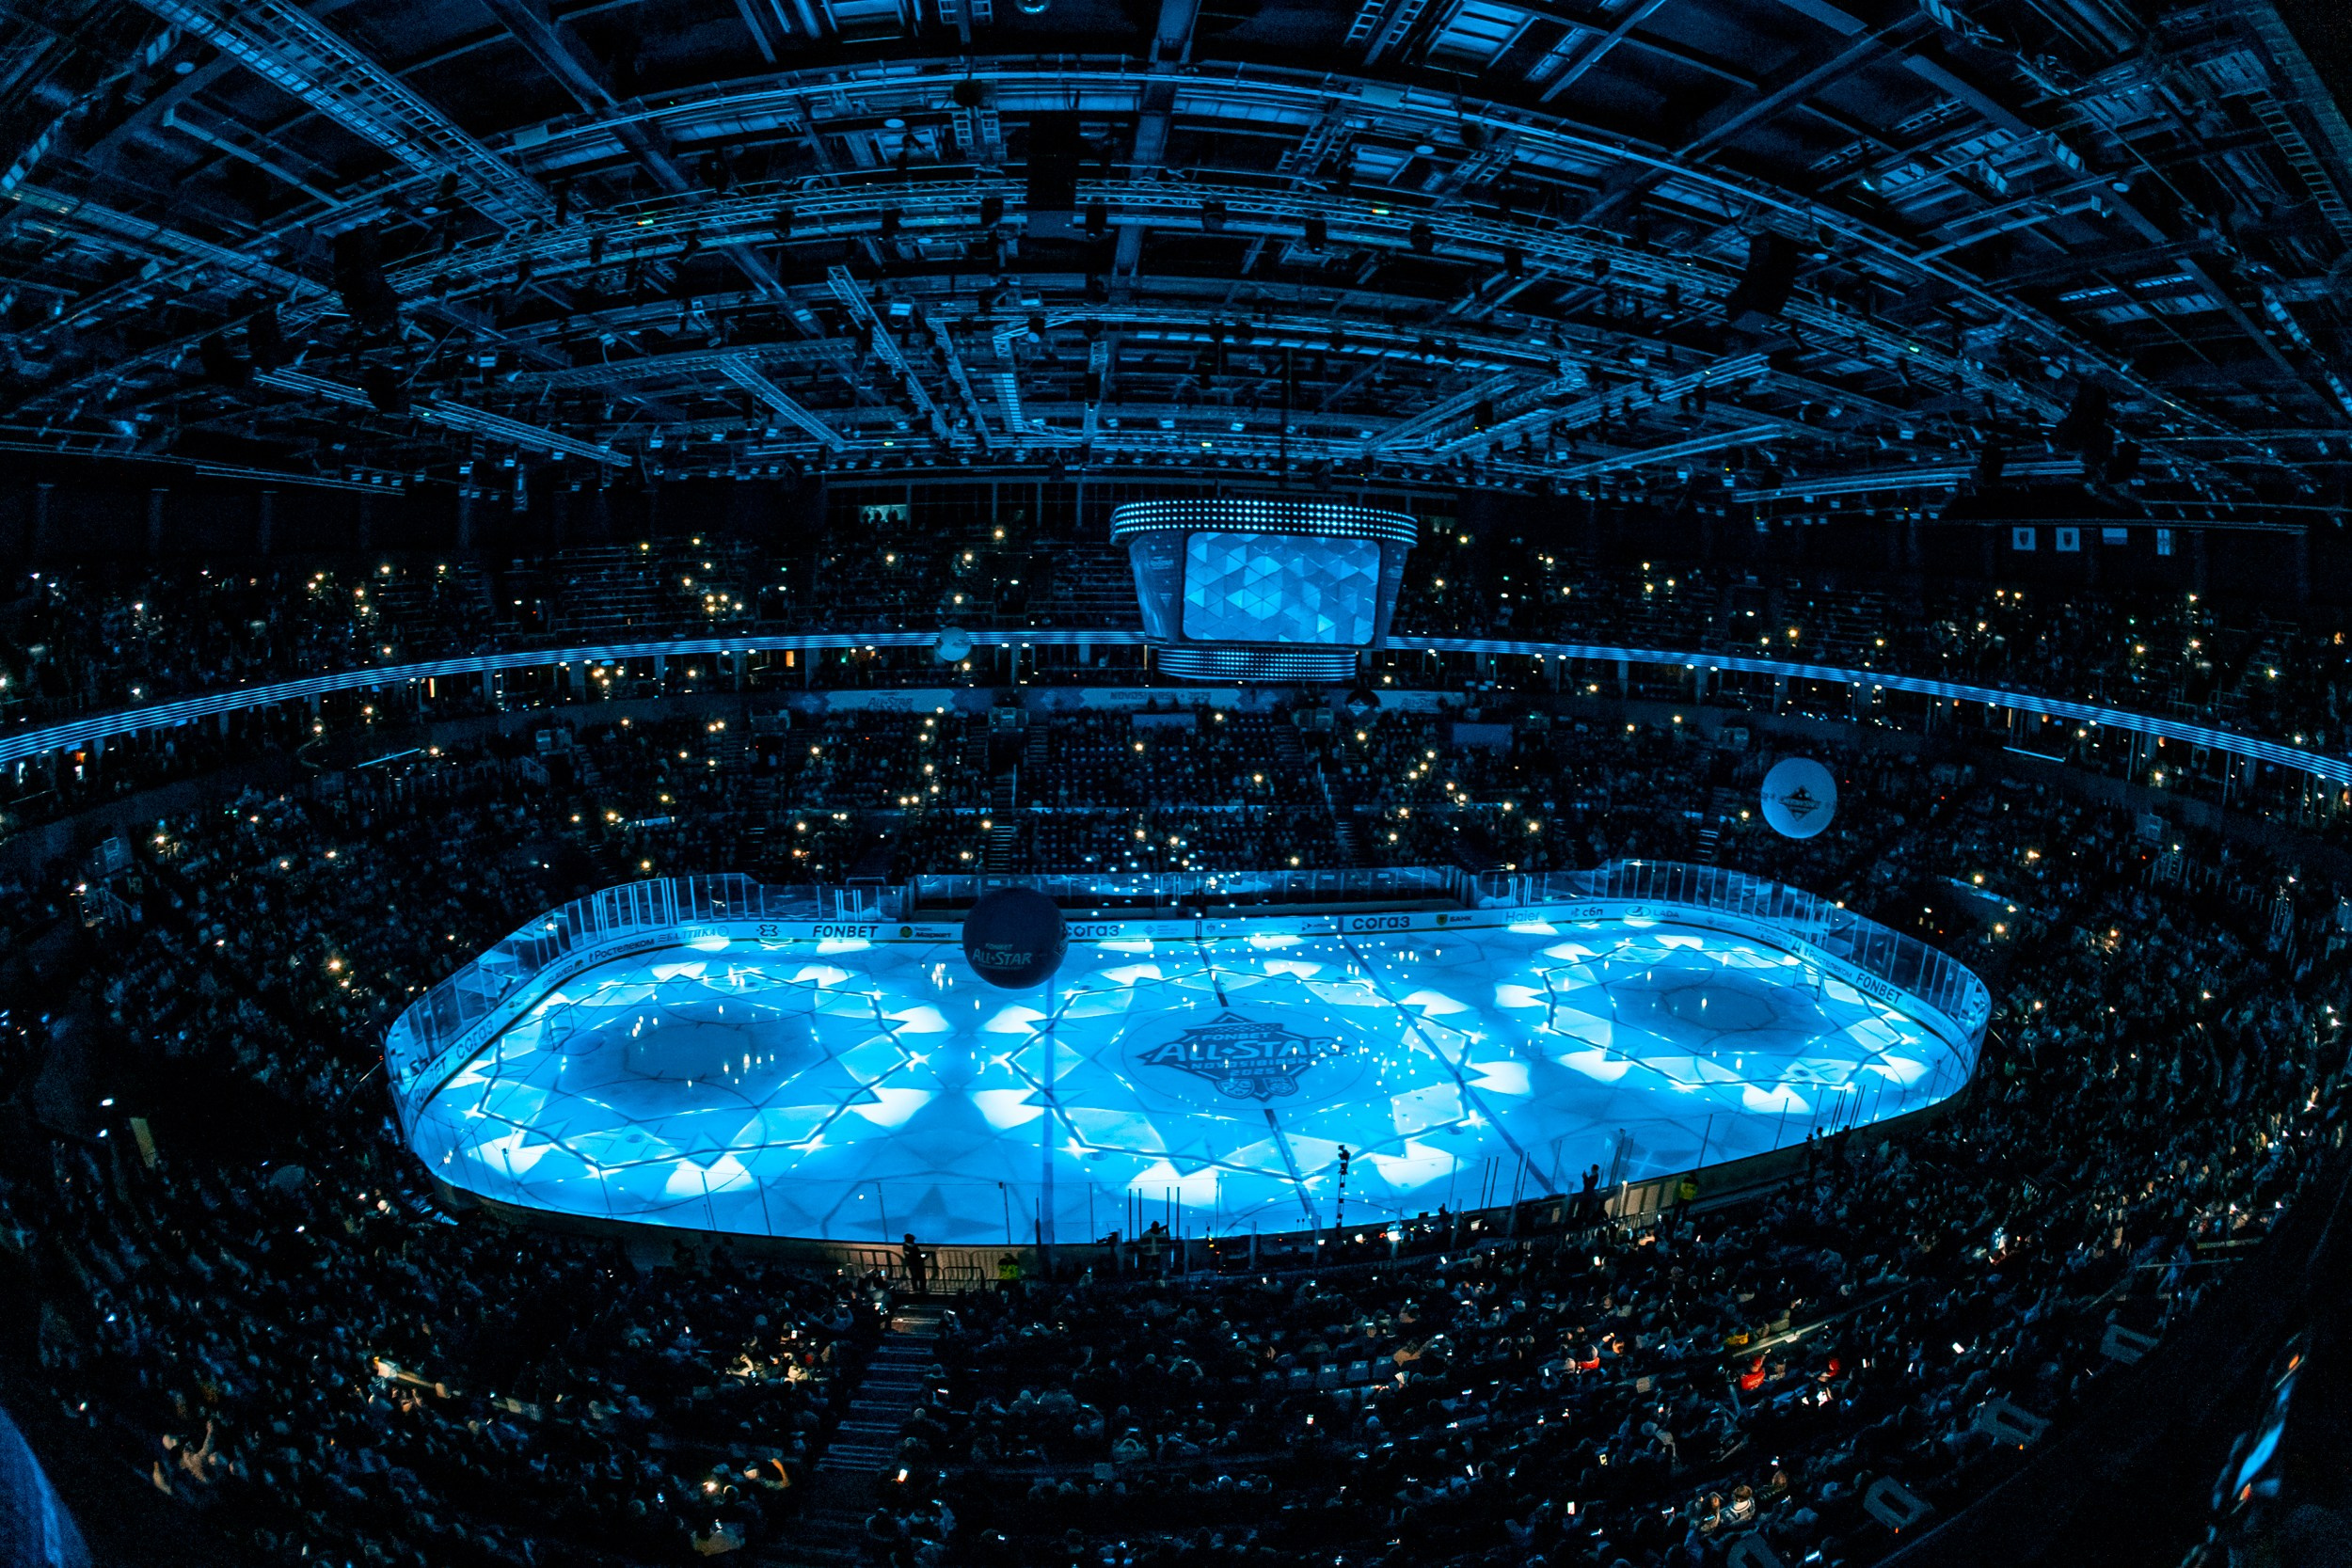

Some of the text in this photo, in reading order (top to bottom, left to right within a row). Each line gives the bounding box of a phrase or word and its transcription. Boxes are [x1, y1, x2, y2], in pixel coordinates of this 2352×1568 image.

[1505, 910, 1541, 923] Haier
[1653, 911, 1680, 919] LADA
[1352, 915, 1410, 930] согаз
[812, 925, 879, 939] FONBET
[595, 938, 655, 959] Ростелеком
[1856, 973, 1903, 1005] FONBET
[1201, 1031, 1270, 1041] FONBET
[1191, 1056, 1311, 1070] NOVOSIBIRSK
[1229, 1067, 1277, 1077] 2025
